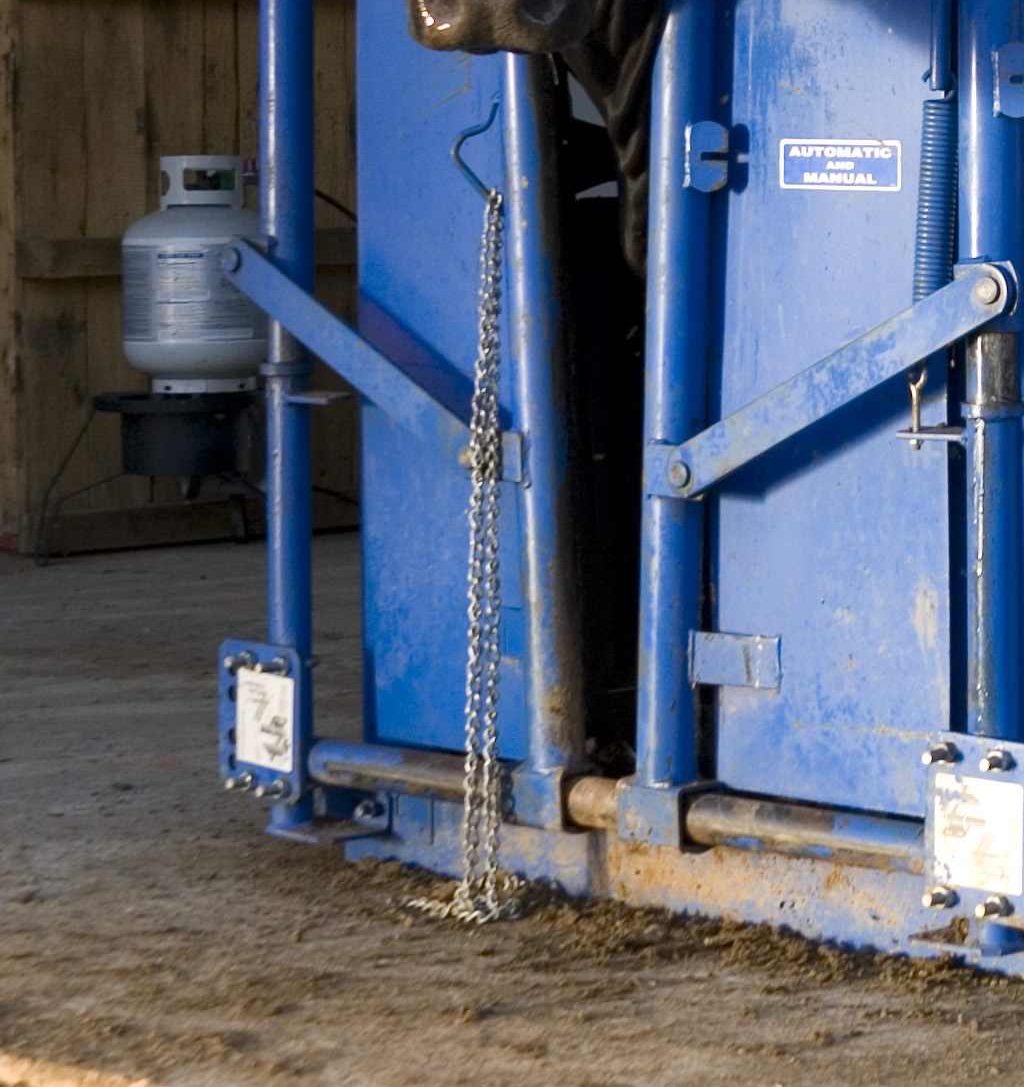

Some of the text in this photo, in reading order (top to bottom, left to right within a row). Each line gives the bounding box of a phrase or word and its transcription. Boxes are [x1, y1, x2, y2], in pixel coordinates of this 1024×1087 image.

[788, 145, 893, 159] AUTOMATIC
[825, 160, 855, 171] AND
[802, 172, 878, 185] MANUAL
